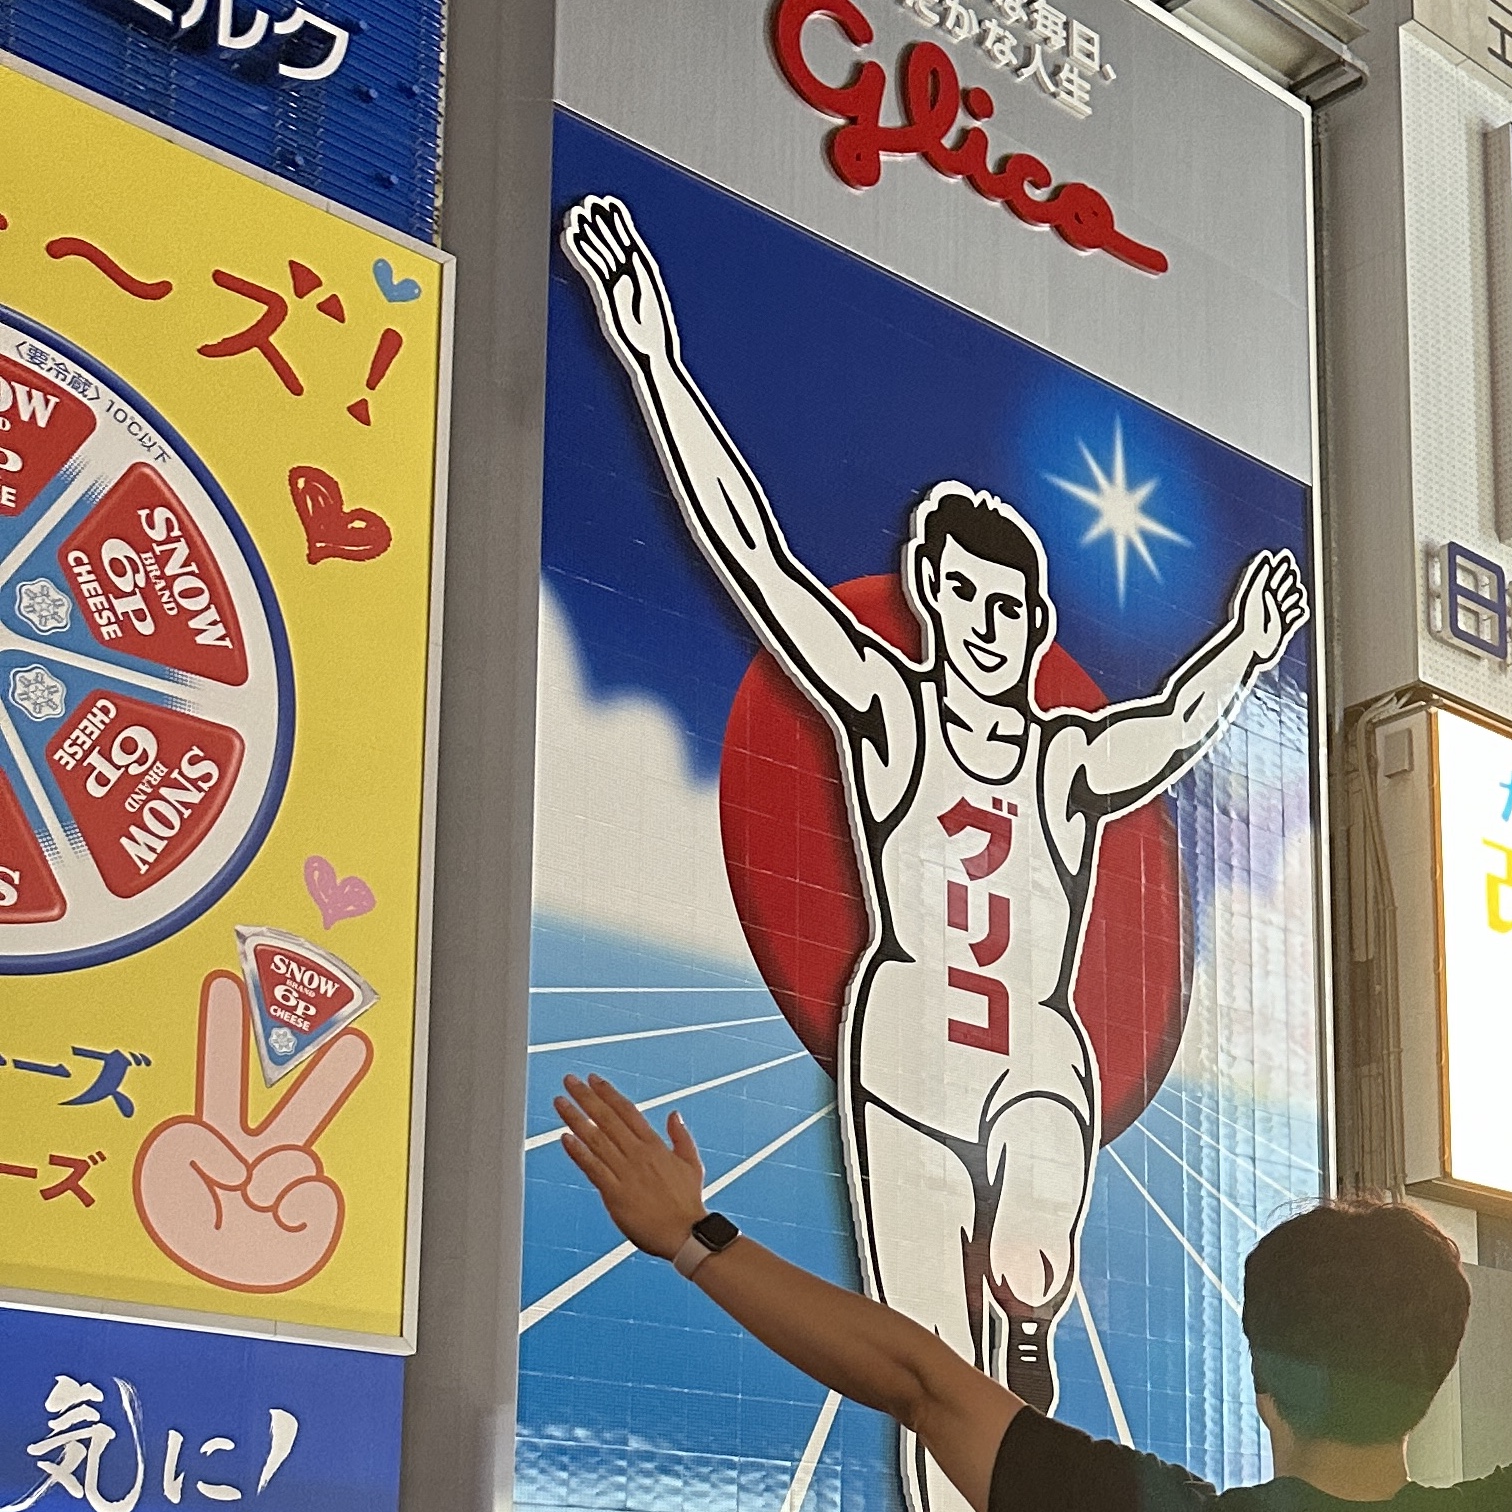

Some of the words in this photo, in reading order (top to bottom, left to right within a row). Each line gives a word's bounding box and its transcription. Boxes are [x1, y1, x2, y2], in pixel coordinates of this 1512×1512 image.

[131, 0, 349, 80] ルク
[774, 0, 1168, 274] Glico
[67, 550, 123, 641] CHEESE
[101, 537, 156, 637] 6P
[137, 505, 233, 650] SNOW
[140, 552, 178, 616] BRAND
[53, 697, 118, 771] CHEESE
[85, 724, 160, 799] 6P
[119, 744, 221, 876] SNOW
[125, 760, 168, 813] BRAND
[937, 796, 1019, 1057] グリコ
[270, 953, 340, 1000] SNOW
[273, 983, 318, 1019] 6P
[285, 978, 316, 1000] BRAND
[269, 1003, 310, 1032] CHEESE
[0, 1044, 152, 1119] ーズ
